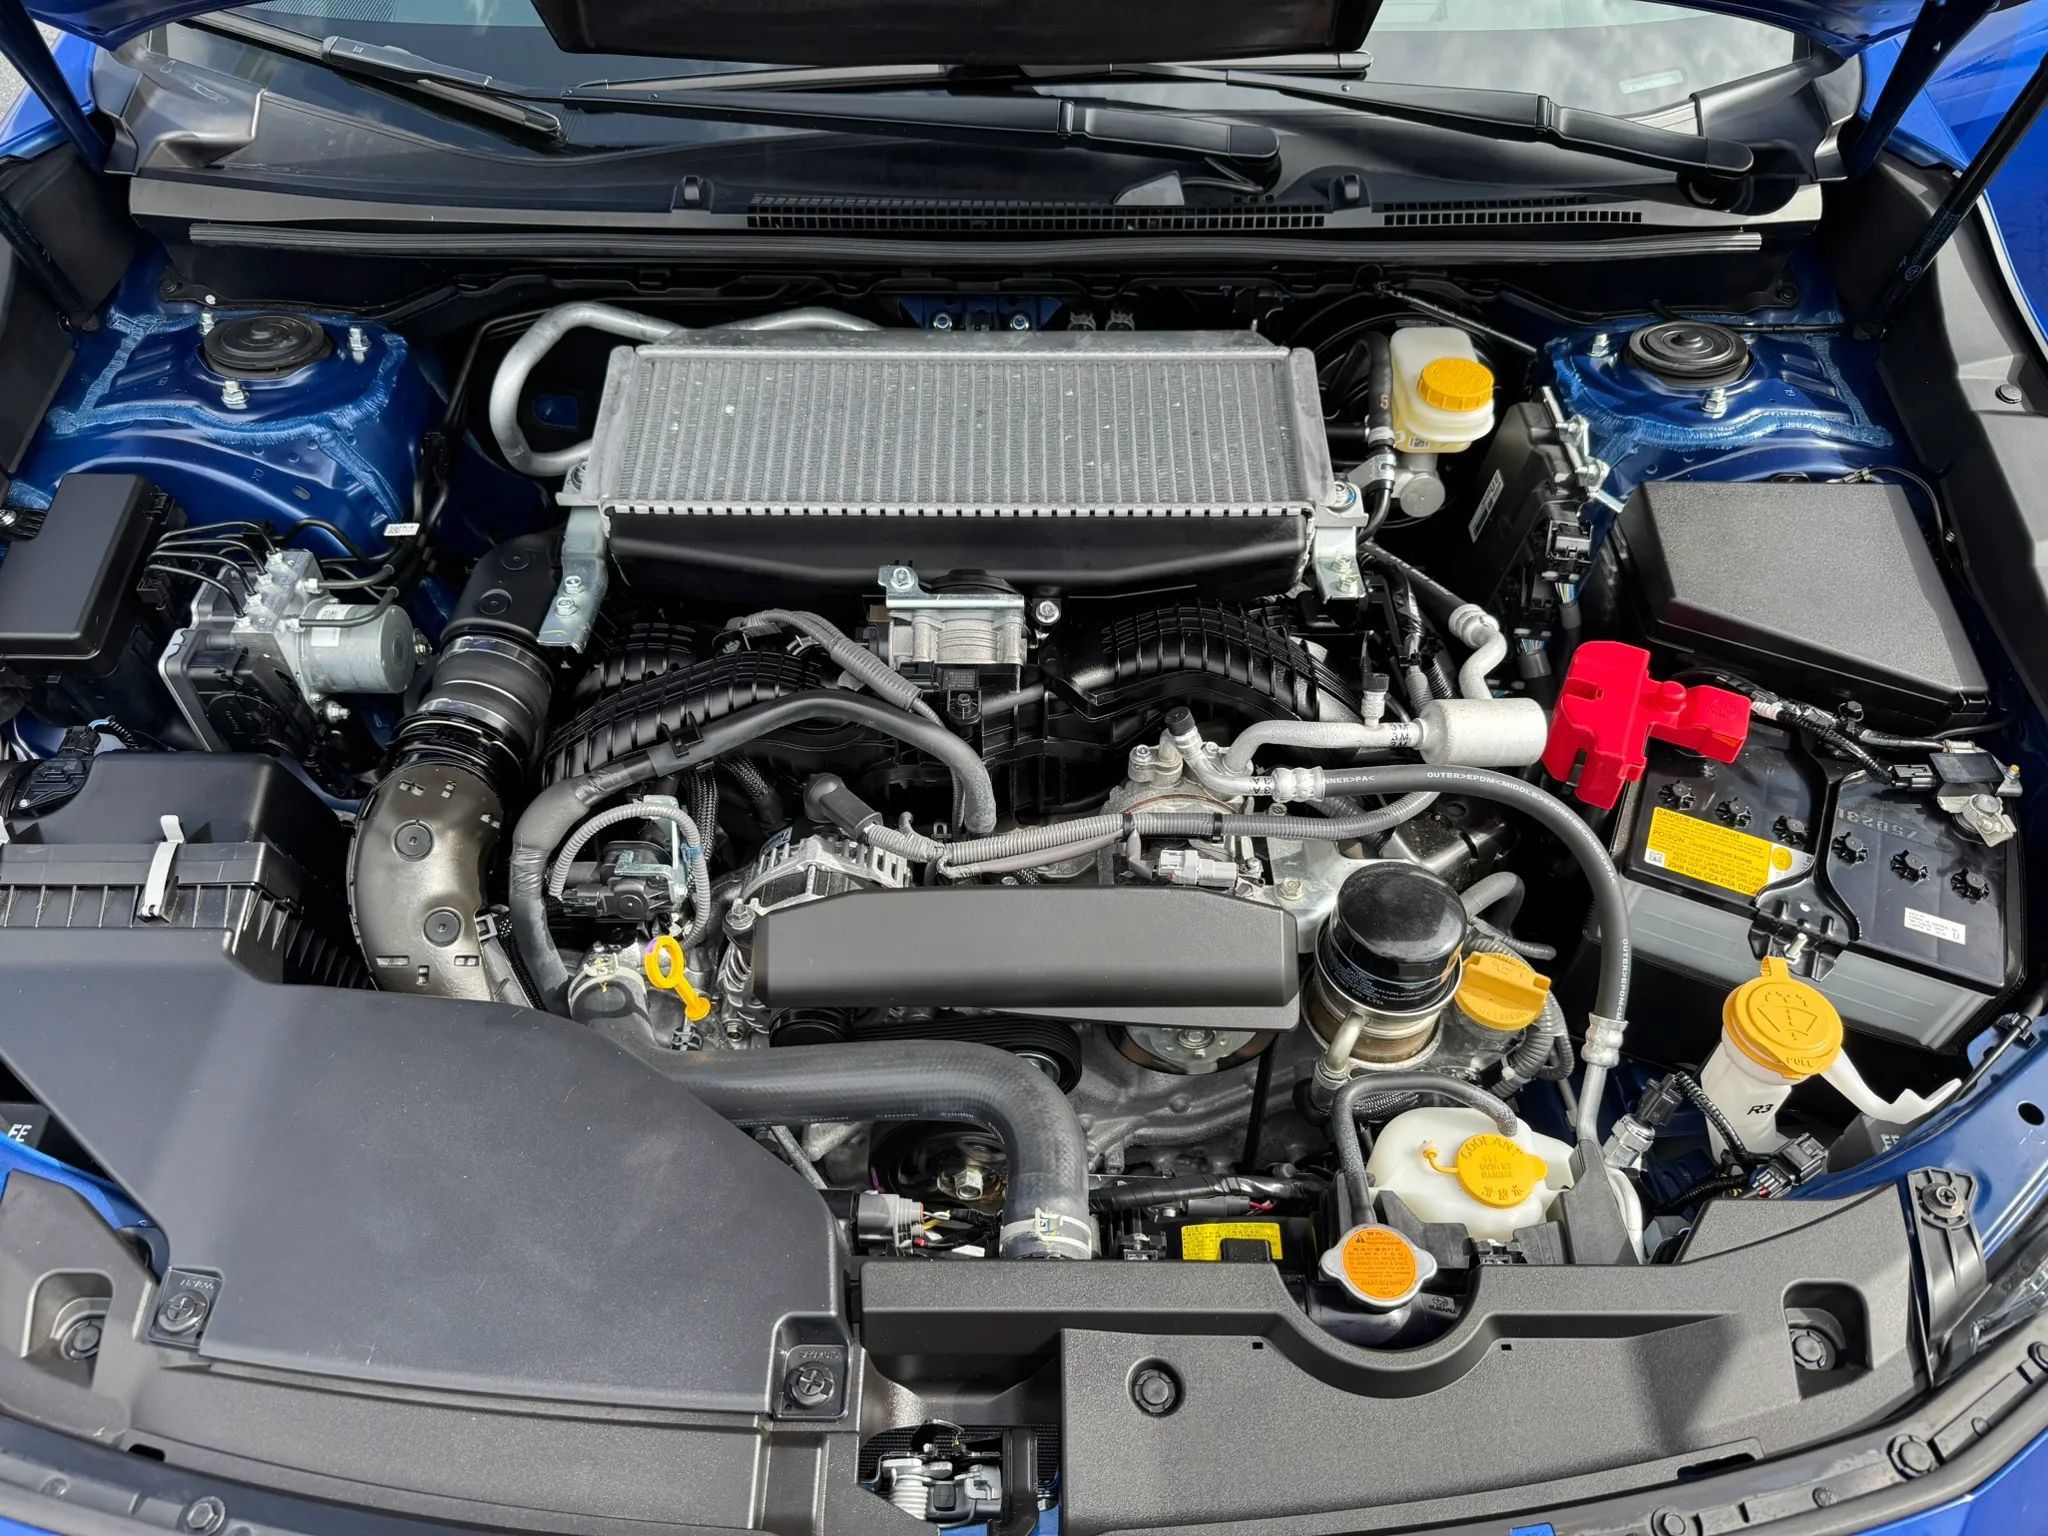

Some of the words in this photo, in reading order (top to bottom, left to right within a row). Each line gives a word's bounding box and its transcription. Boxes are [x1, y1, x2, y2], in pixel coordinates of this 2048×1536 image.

[1653, 829, 1685, 844] POISON
[1747, 1103, 1774, 1116] R3
[1460, 1135, 1523, 1159] COOLANT
